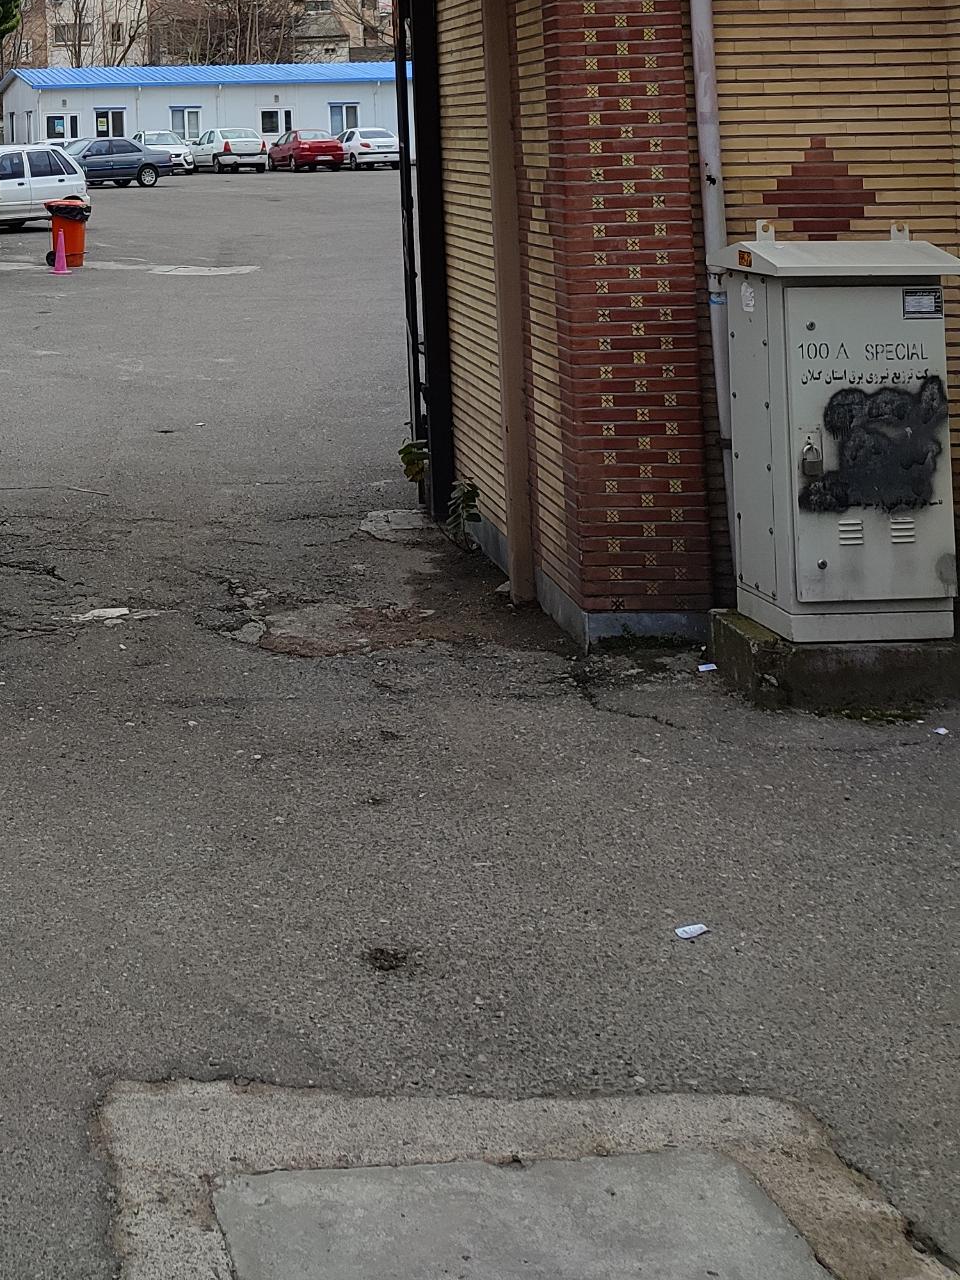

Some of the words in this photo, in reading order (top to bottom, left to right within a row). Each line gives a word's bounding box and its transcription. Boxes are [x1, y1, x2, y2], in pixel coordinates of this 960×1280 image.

[798, 342, 830, 359] 100
[864, 343, 929, 361] SPECIAL
[824, 369, 847, 385] استان
